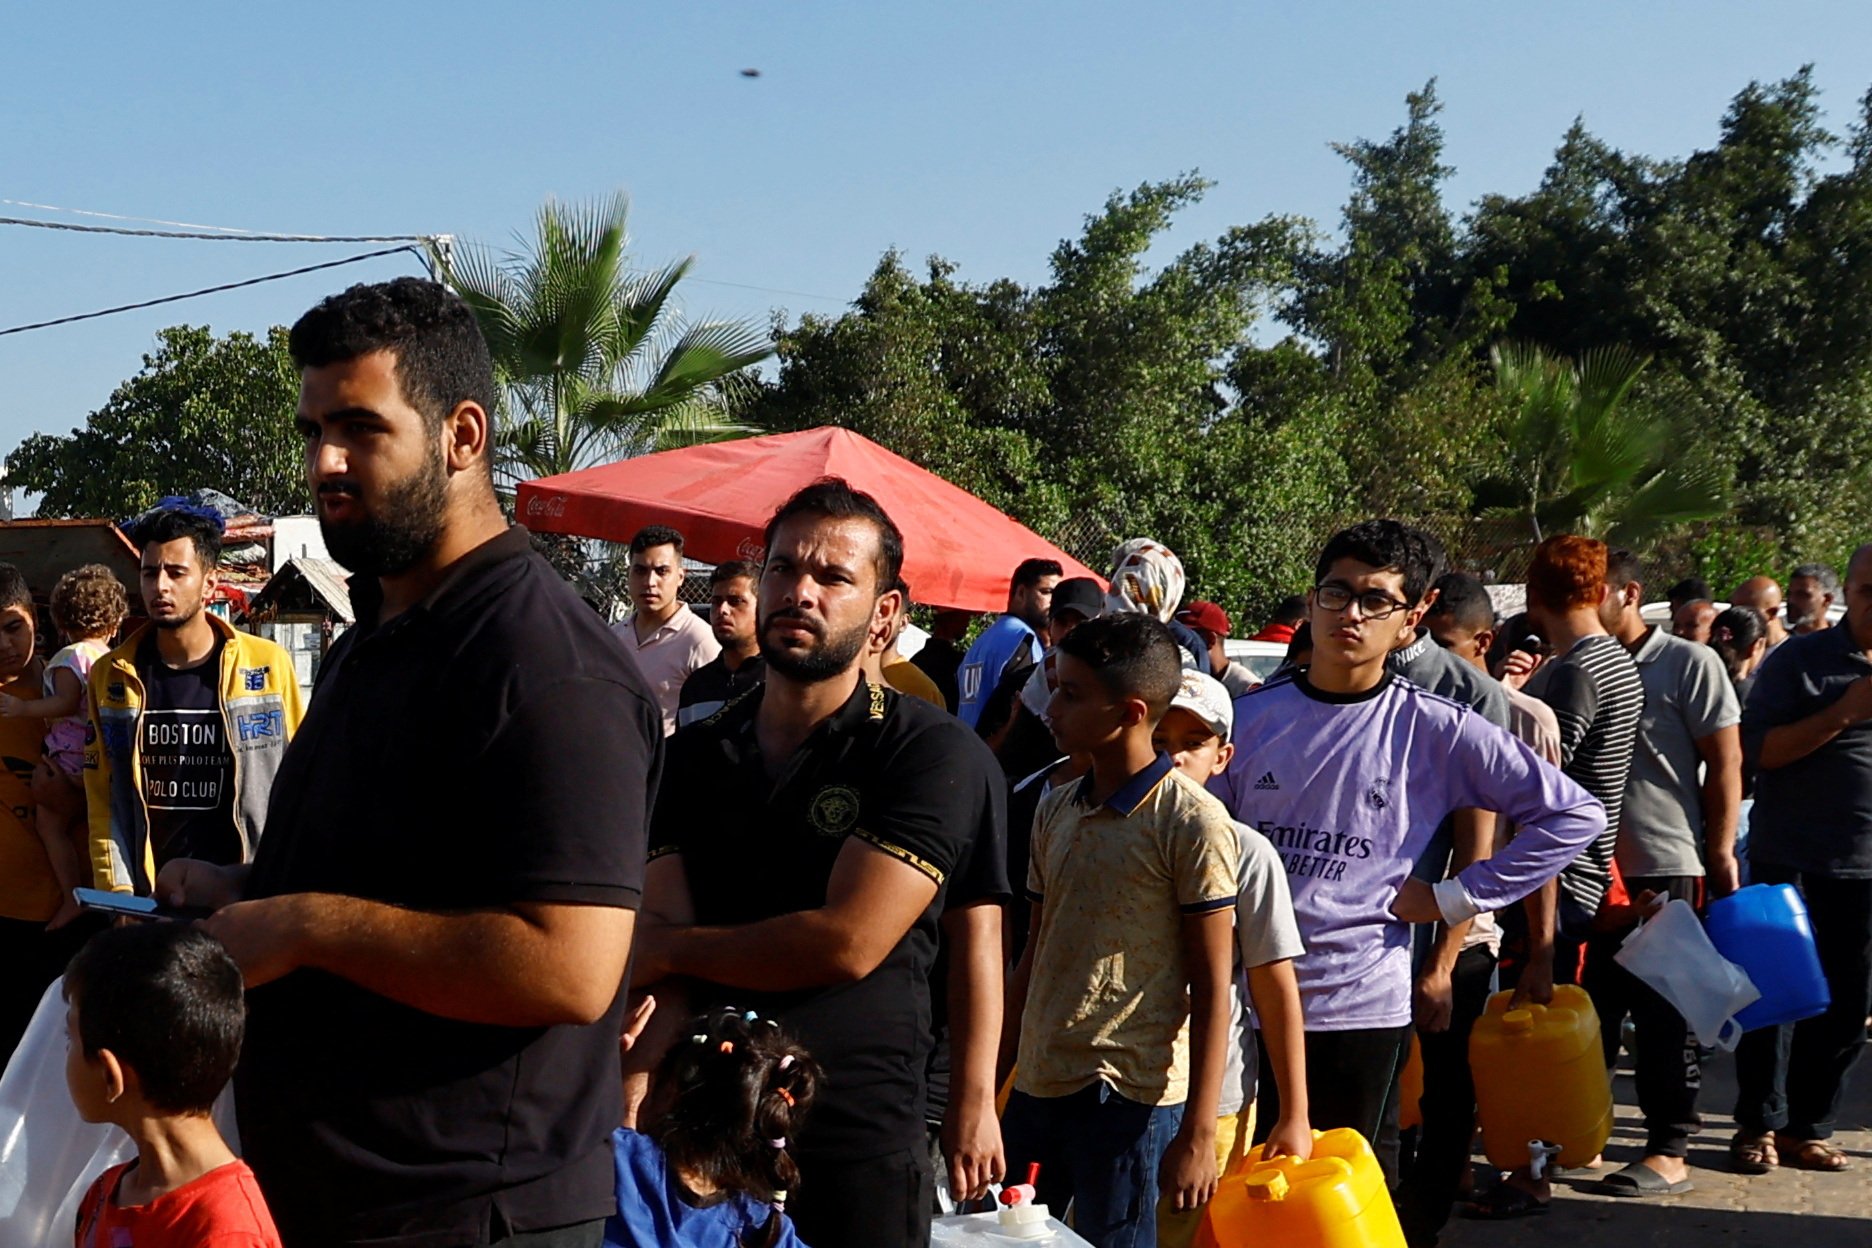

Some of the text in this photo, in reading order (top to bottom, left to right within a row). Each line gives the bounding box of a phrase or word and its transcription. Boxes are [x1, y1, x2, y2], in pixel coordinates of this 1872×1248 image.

[1395, 641, 1426, 667] NIKE
[964, 666, 982, 699] UN
[149, 723, 216, 745] BOSTON
[149, 780, 217, 798] POLO CLUB
[1258, 820, 1373, 859] Emirates
[1288, 853, 1347, 882] BETTER
